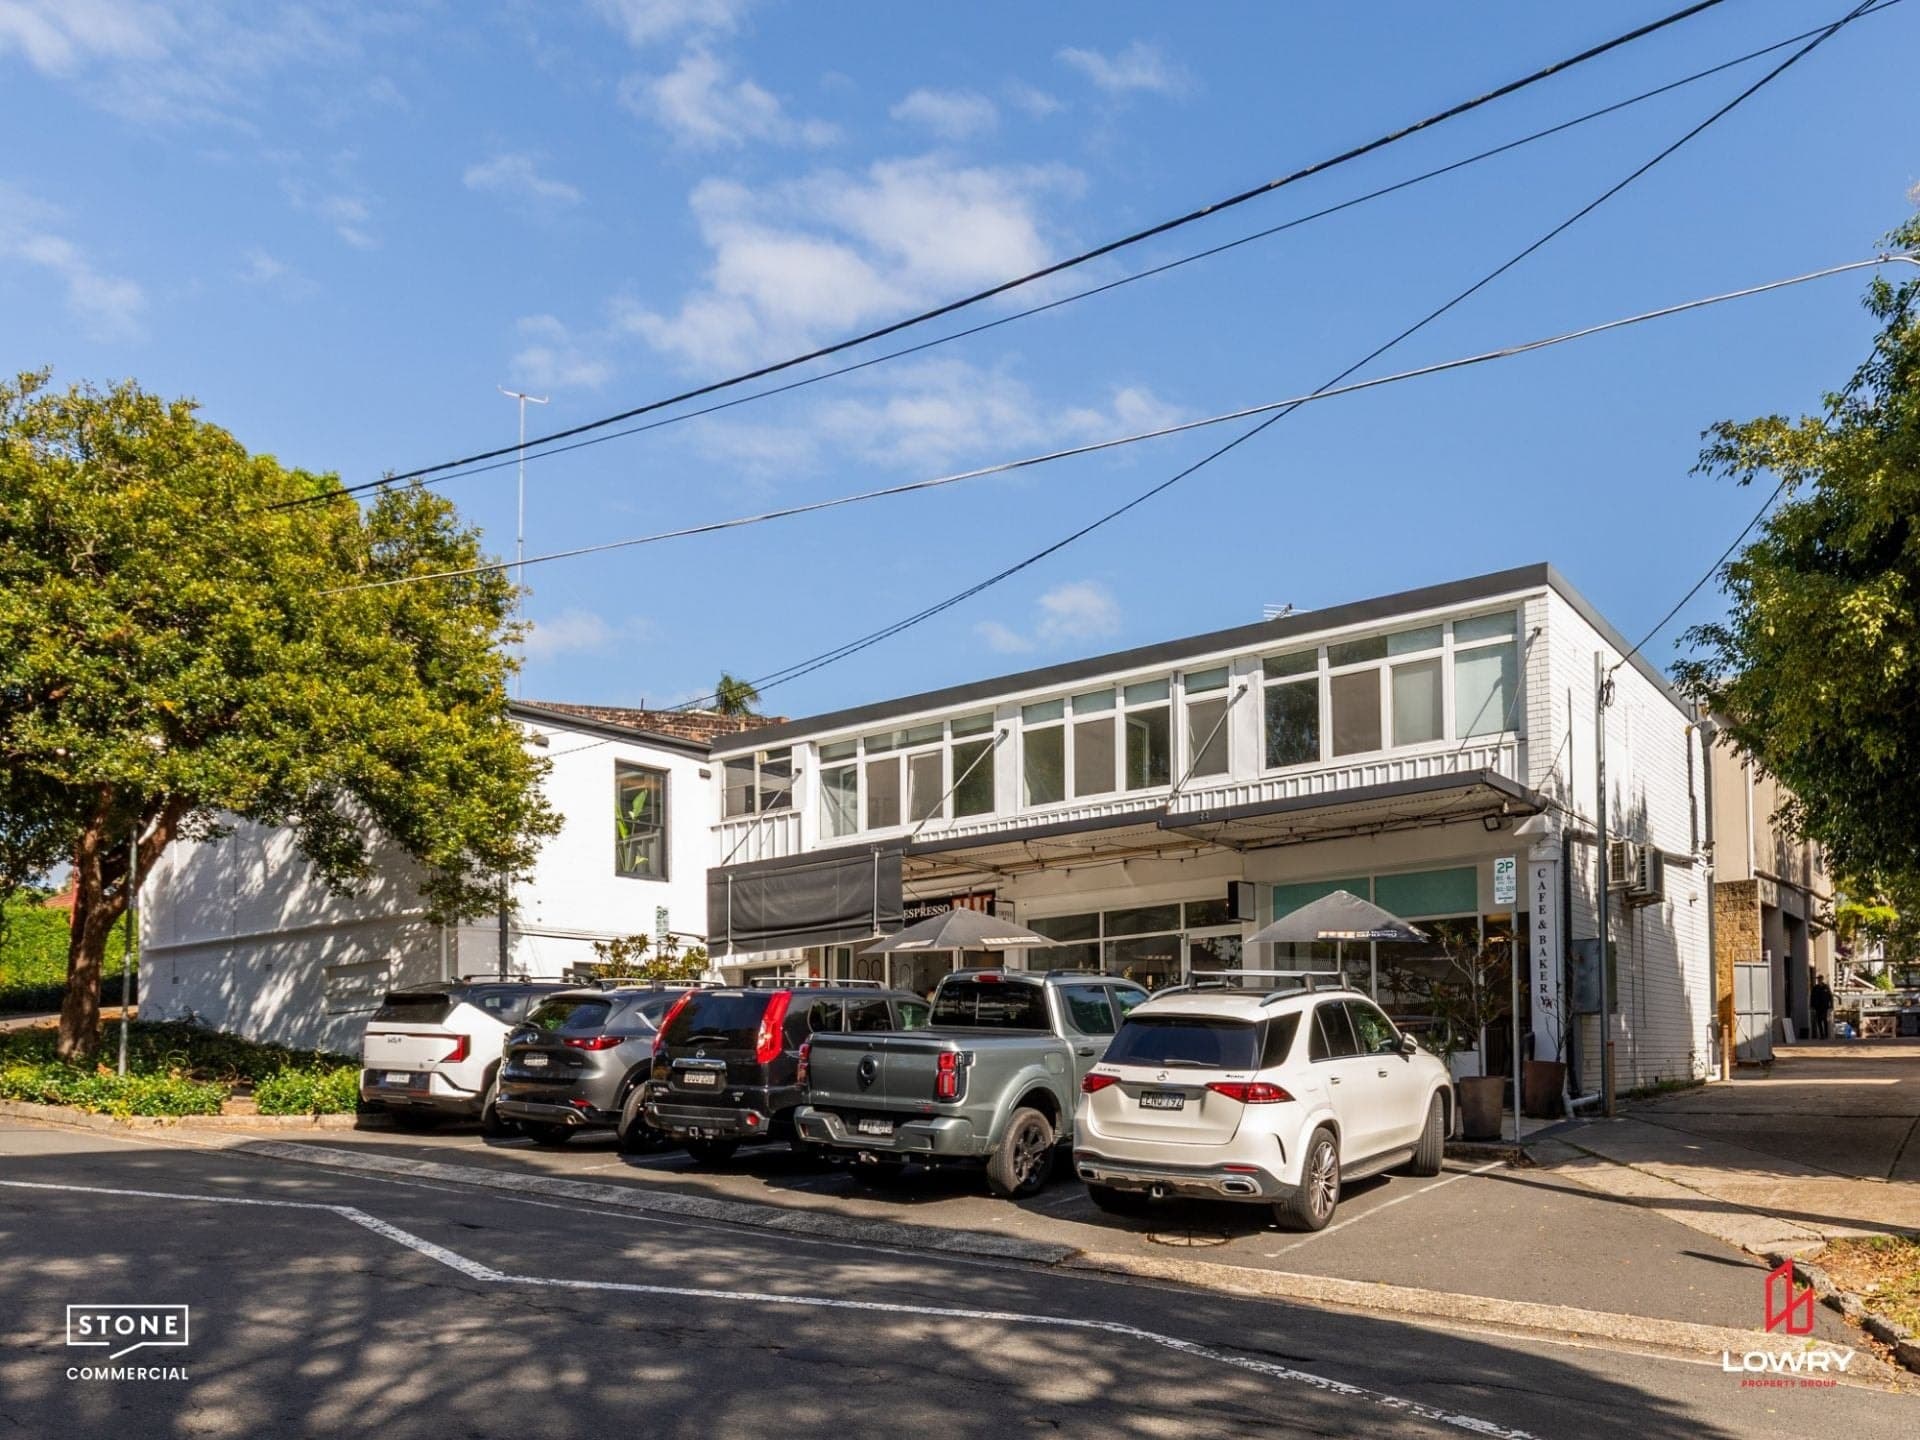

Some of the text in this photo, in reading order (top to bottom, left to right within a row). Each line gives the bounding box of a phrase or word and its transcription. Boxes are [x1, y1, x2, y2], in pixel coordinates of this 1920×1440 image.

[1497, 861, 1514, 874] 2P
[656, 910, 669, 920] 2P
[903, 903, 951, 919] ESPRESSO
[1537, 867, 1549, 1006] CAFE & BAKERY
